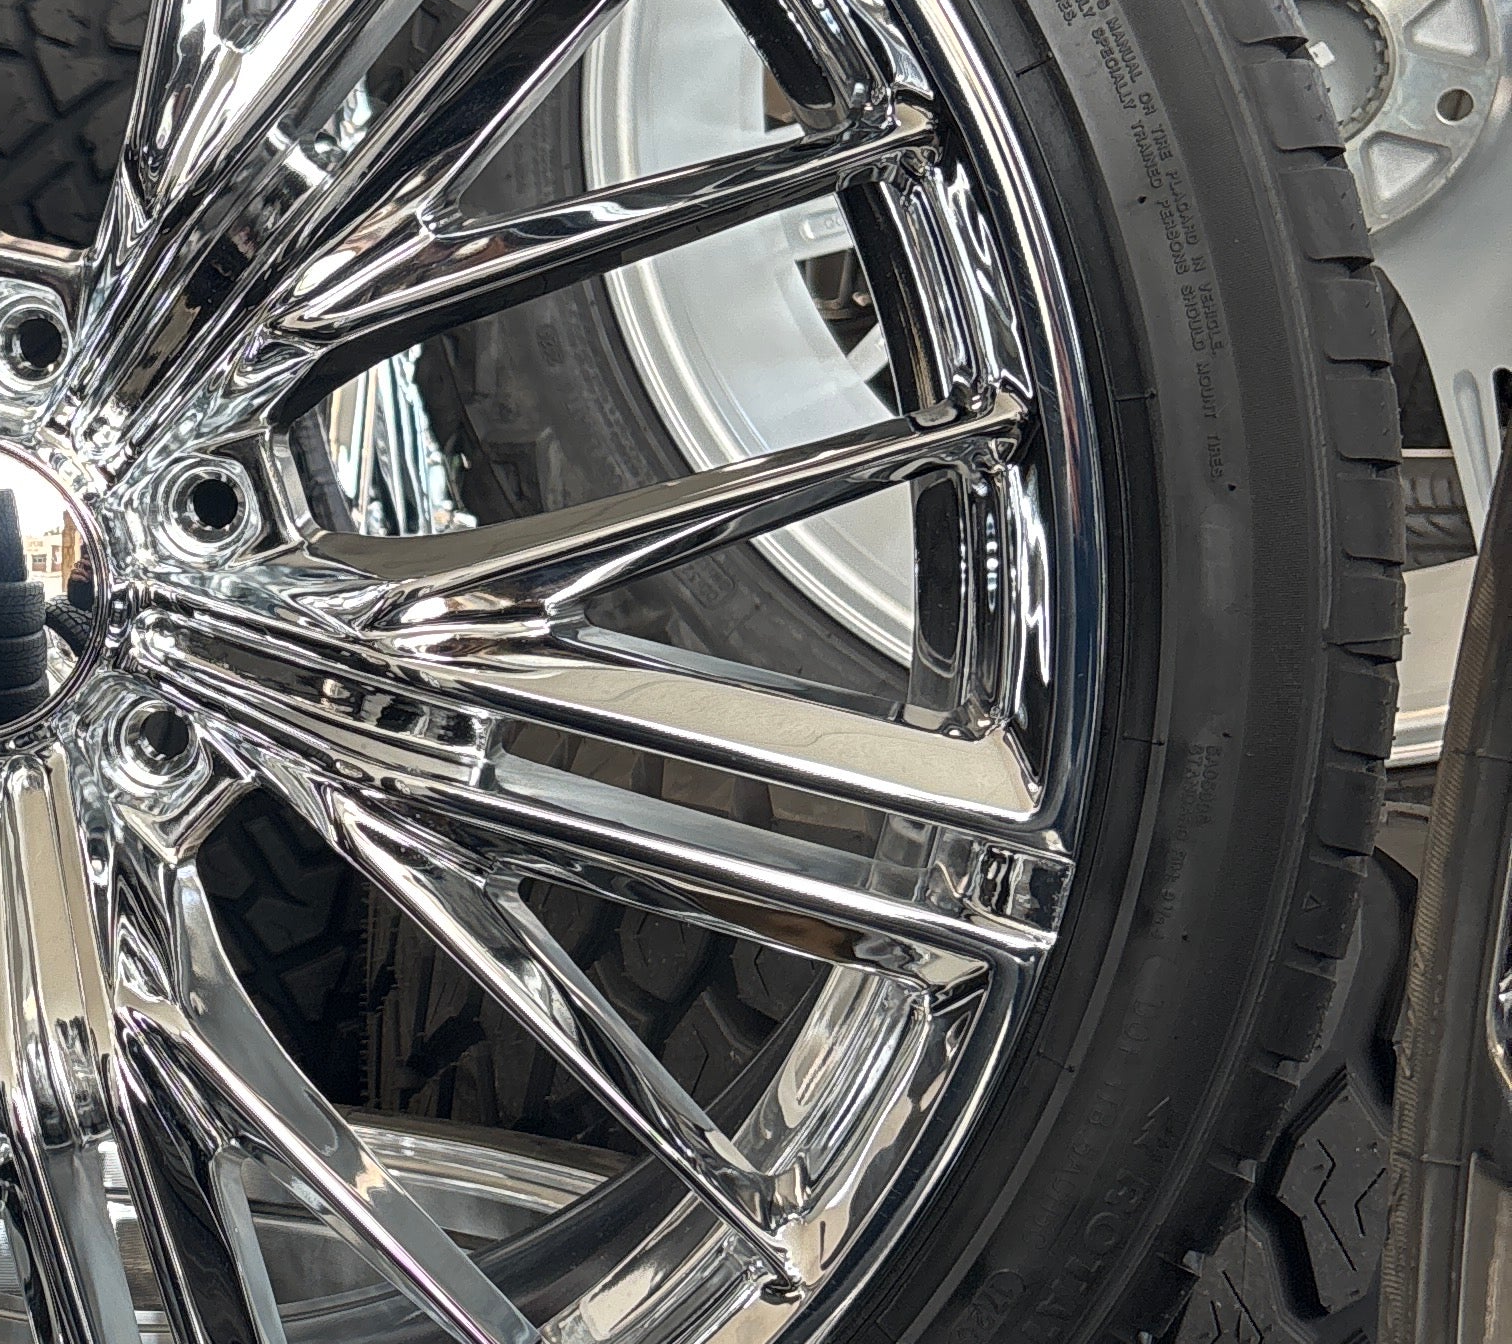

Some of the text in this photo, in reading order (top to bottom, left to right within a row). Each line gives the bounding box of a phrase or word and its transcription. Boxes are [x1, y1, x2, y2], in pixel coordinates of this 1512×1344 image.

[1087, 23, 1139, 114] SPECIALLY
[1126, 116, 1165, 192] TRAINED
[1154, 195, 1190, 277] PERSONS
[1178, 282, 1207, 353] SHOULD
[1194, 359, 1218, 421] MOUNT
[1102, 13, 1145, 84] MANUAL
[1134, 87, 1159, 118] OR
[1147, 121, 1174, 163] TIRE
[1163, 166, 1201, 247] PLACARD
[1188, 251, 1208, 275] IN
